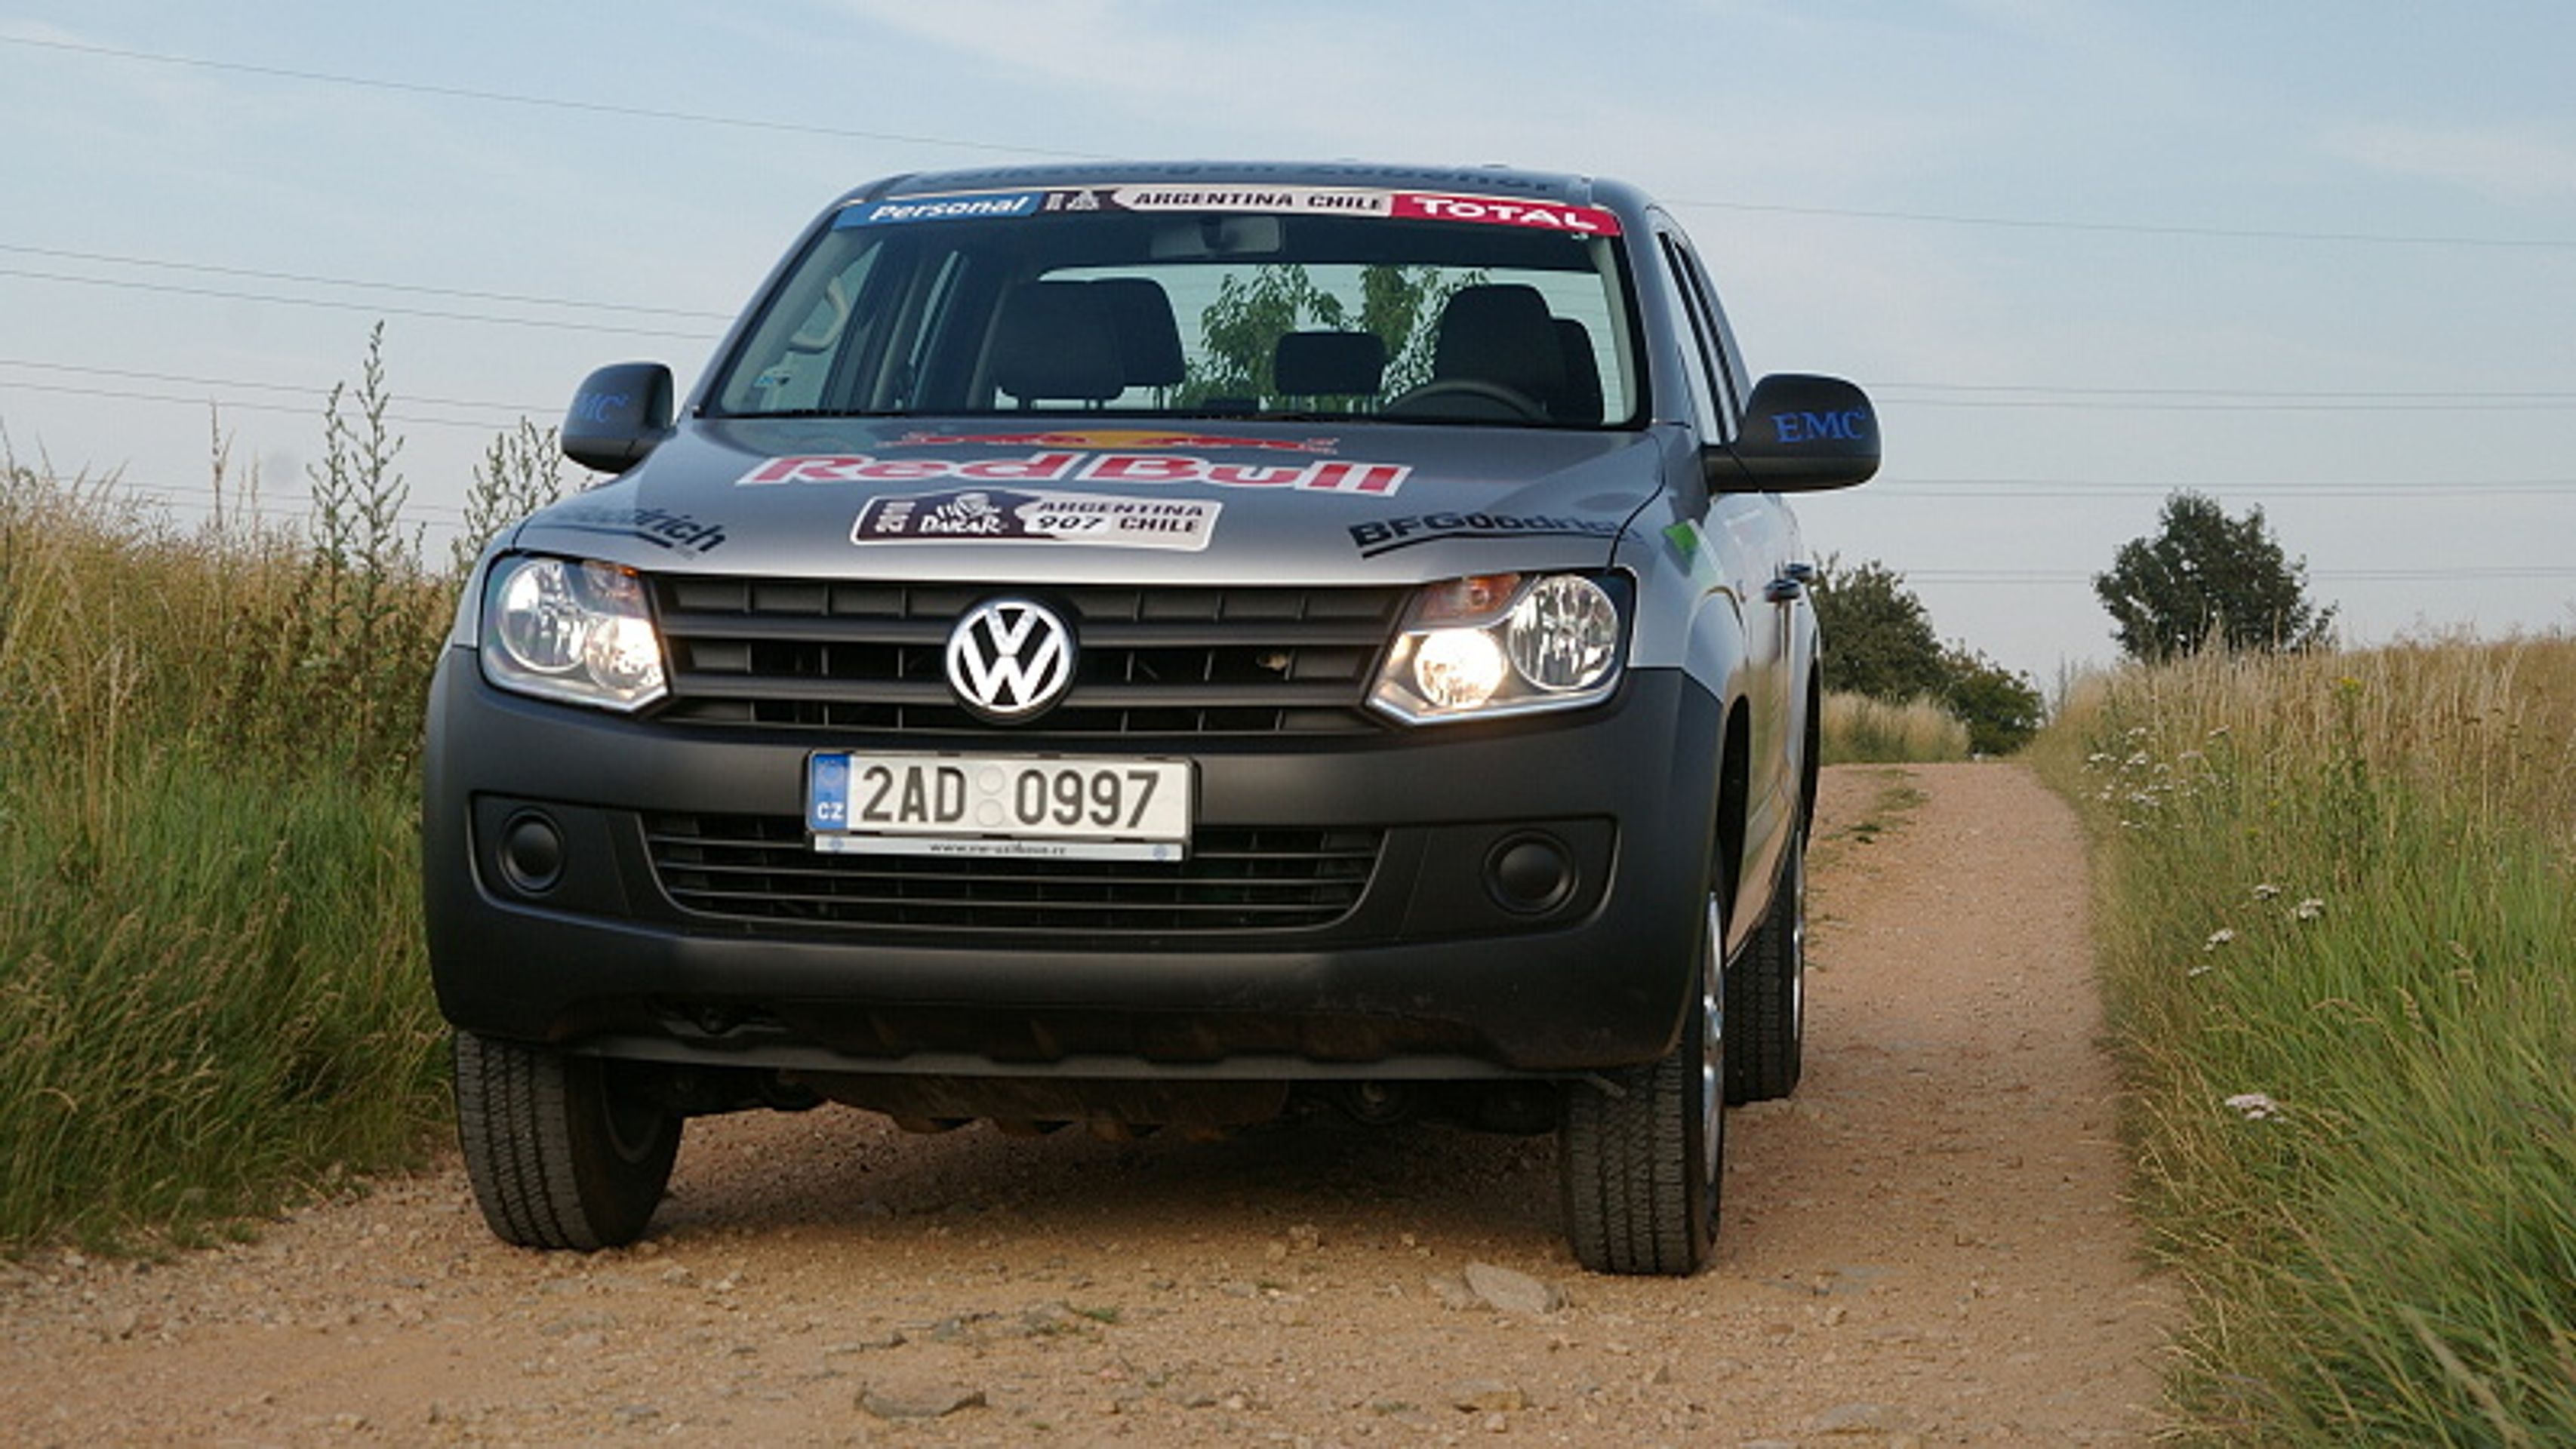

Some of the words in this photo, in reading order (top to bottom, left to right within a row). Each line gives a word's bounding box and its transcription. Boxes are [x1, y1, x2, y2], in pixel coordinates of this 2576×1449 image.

[869, 195, 1029, 221] Personal
[1133, 192, 1293, 205] ARGENTINA
[1307, 193, 1383, 210] CHILE
[1412, 195, 1598, 230] TOTAL
[735, 453, 1073, 485] Red
[1074, 454, 1412, 497] Bull
[1037, 502, 1203, 516] ARGENTINA
[919, 515, 1003, 534] DAKAR
[1039, 515, 1103, 530] 907
[1119, 518, 1200, 533] CHILE
[861, 765, 966, 824] 2AD
[1015, 768, 1161, 829] 0997
[817, 802, 845, 820] CZ
